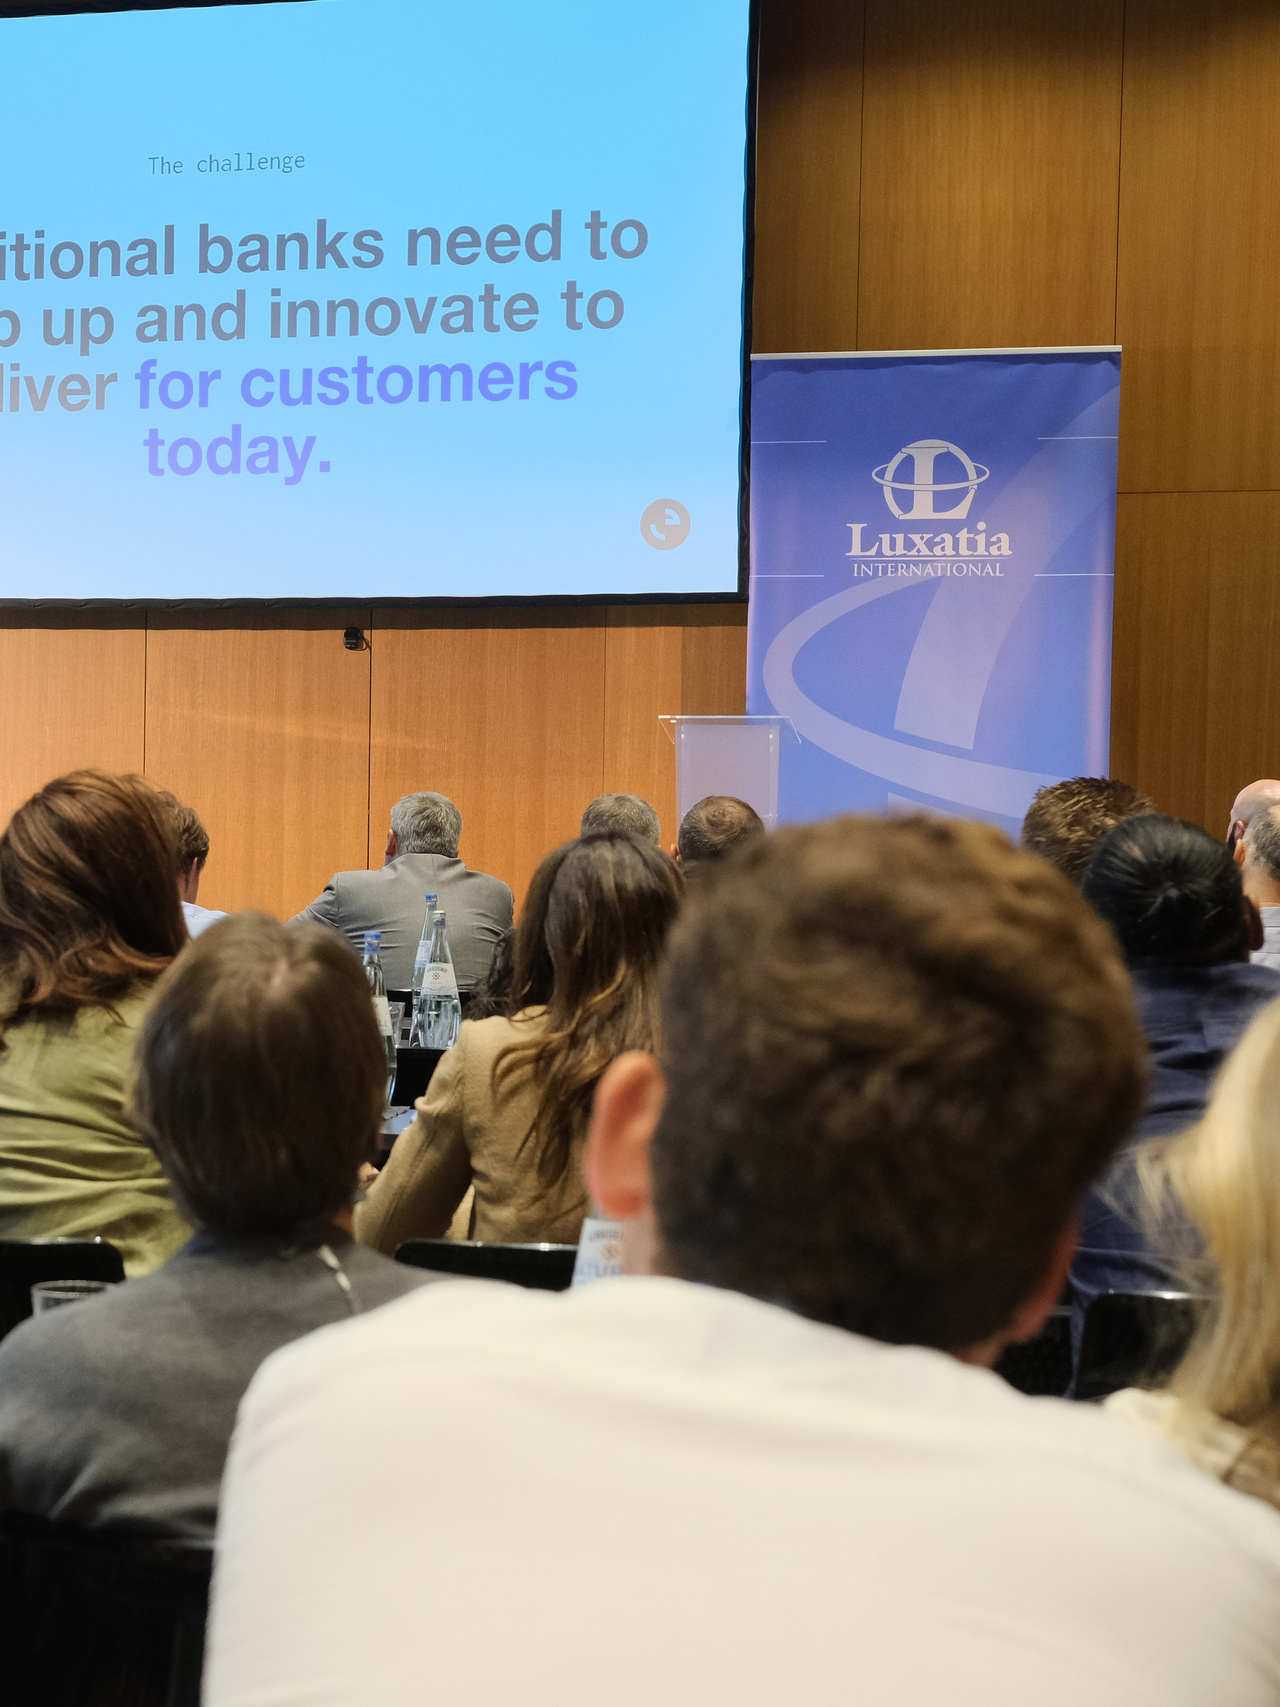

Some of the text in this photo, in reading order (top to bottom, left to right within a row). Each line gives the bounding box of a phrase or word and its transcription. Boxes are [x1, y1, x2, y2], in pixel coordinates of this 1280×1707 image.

[148, 153, 306, 175] The challenge
[199, 219, 385, 274] banks
[408, 209, 563, 266] need
[585, 210, 649, 260] to
[43, 307, 115, 357] up
[136, 289, 247, 343] and
[271, 284, 540, 338] innovate
[561, 281, 625, 330] to
[135, 359, 222, 409] for
[241, 356, 579, 407] customers
[143, 424, 331, 486] today.
[846, 521, 1012, 556] Luxatia
[853, 562, 1004, 577] INTERNATIONAL
